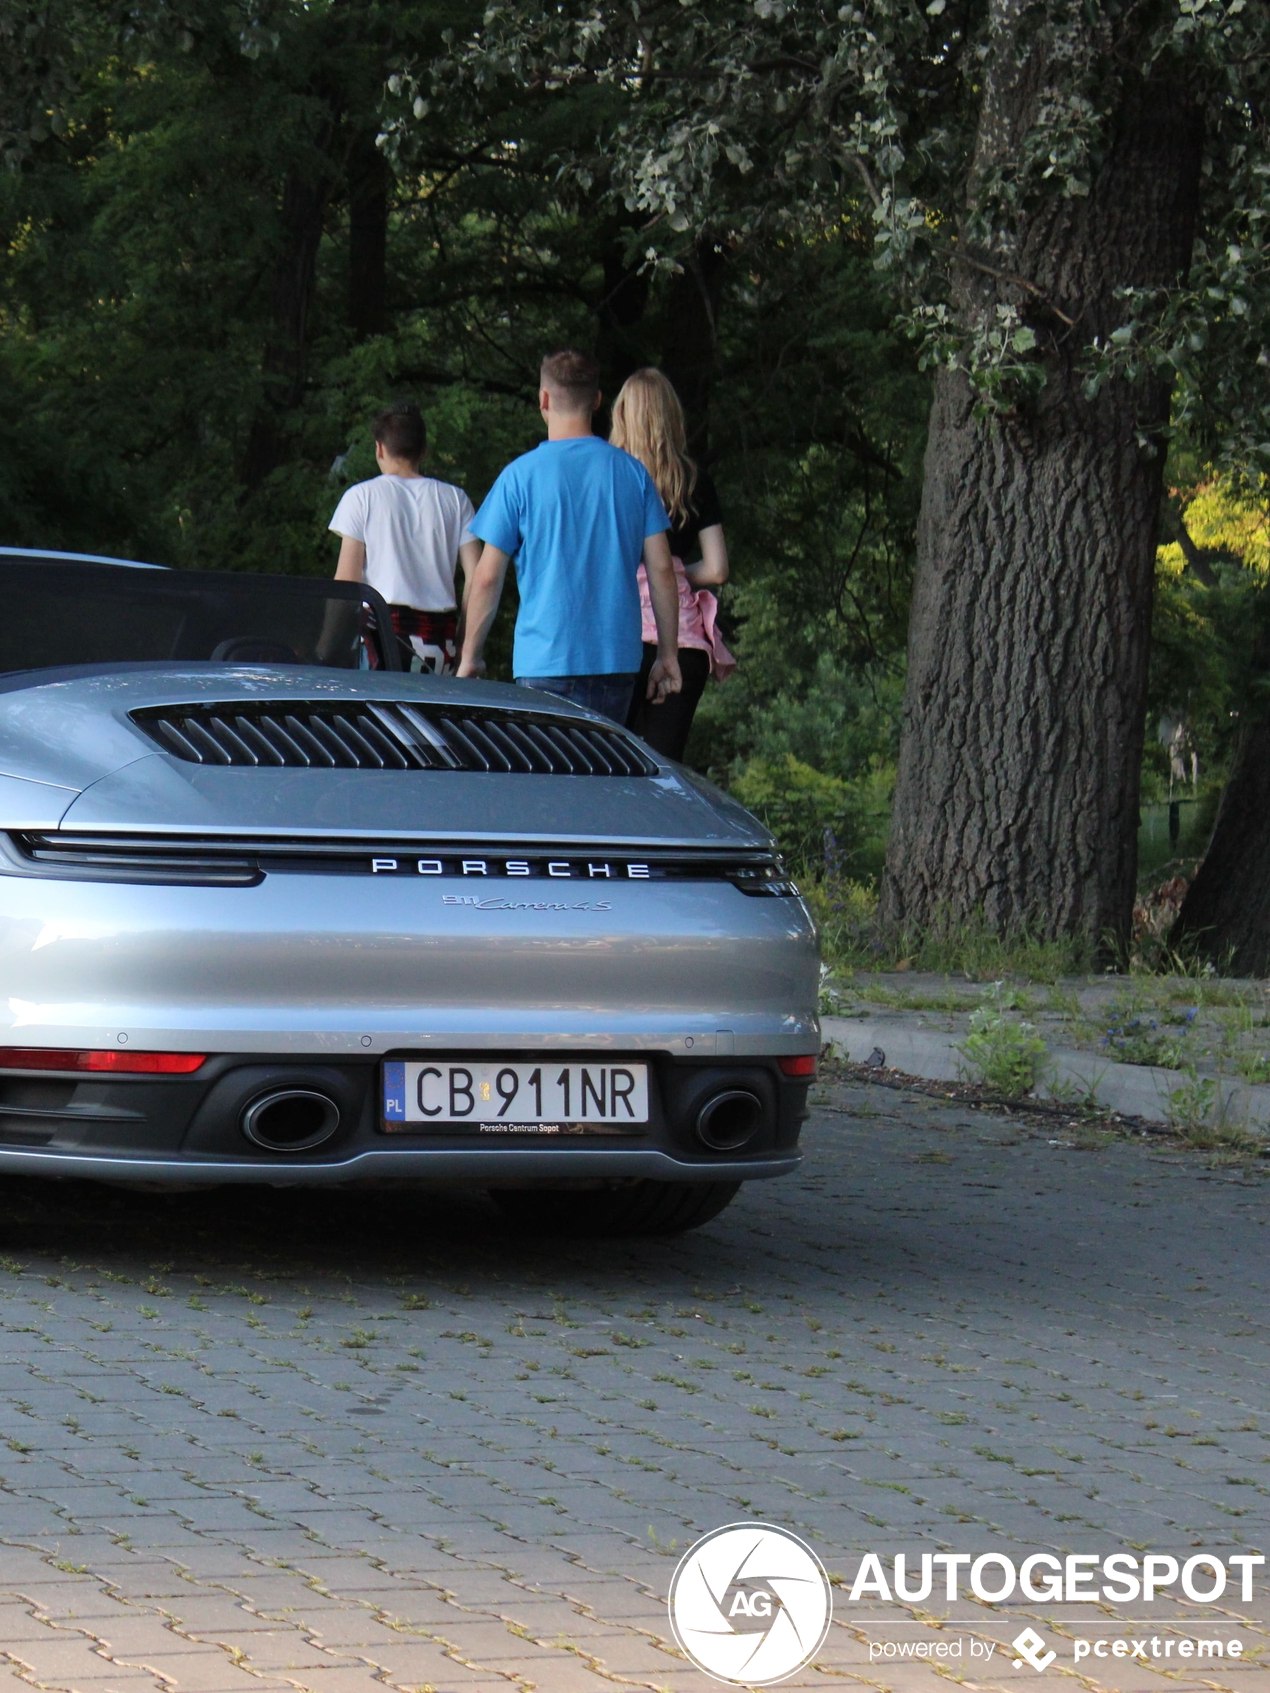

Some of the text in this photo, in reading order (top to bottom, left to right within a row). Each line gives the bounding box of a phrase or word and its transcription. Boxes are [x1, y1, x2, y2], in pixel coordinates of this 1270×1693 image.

[372, 858, 650, 878] PORSCHE
[475, 897, 569, 910] Carrera
[417, 1067, 636, 1117] CB 911NR
[386, 1099, 402, 1112] PL
[480, 1123, 559, 1133] Porsche Centrum Sopot
